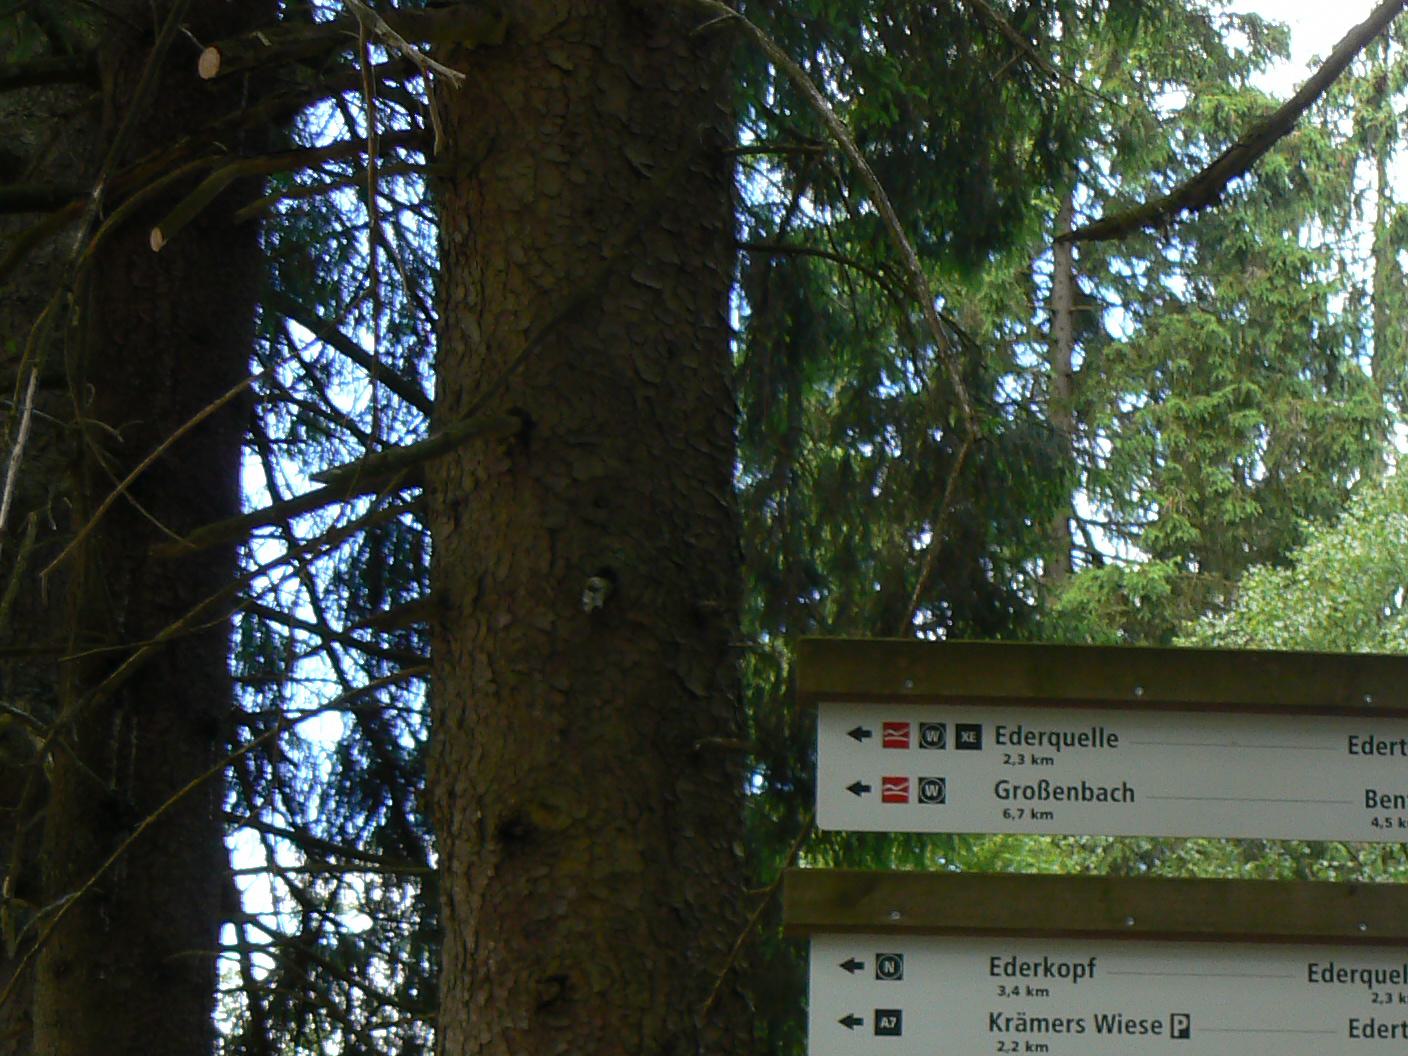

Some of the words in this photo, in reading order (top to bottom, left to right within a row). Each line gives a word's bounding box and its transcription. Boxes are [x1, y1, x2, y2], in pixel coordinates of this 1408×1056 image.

[960, 731, 977, 743] XE
[995, 725, 1119, 752] Ederquelle
[1003, 754, 1025, 767] 2,3
[1031, 753, 1054, 766] km
[995, 778, 1135, 803] Großenbach
[1003, 808, 1025, 822] 6,7
[1031, 807, 1054, 820] km
[1371, 817, 1393, 830] 4,5
[989, 956, 1097, 983] Ederkopf
[997, 985, 1021, 998] 3,4
[1026, 984, 1050, 997] km
[1371, 992, 1393, 1005] 2,3
[989, 1011, 1086, 1034] Krämers
[1094, 1012, 1163, 1035] Wiese
[996, 1040, 1019, 1053] 2,2
[1025, 1040, 1049, 1053] km
